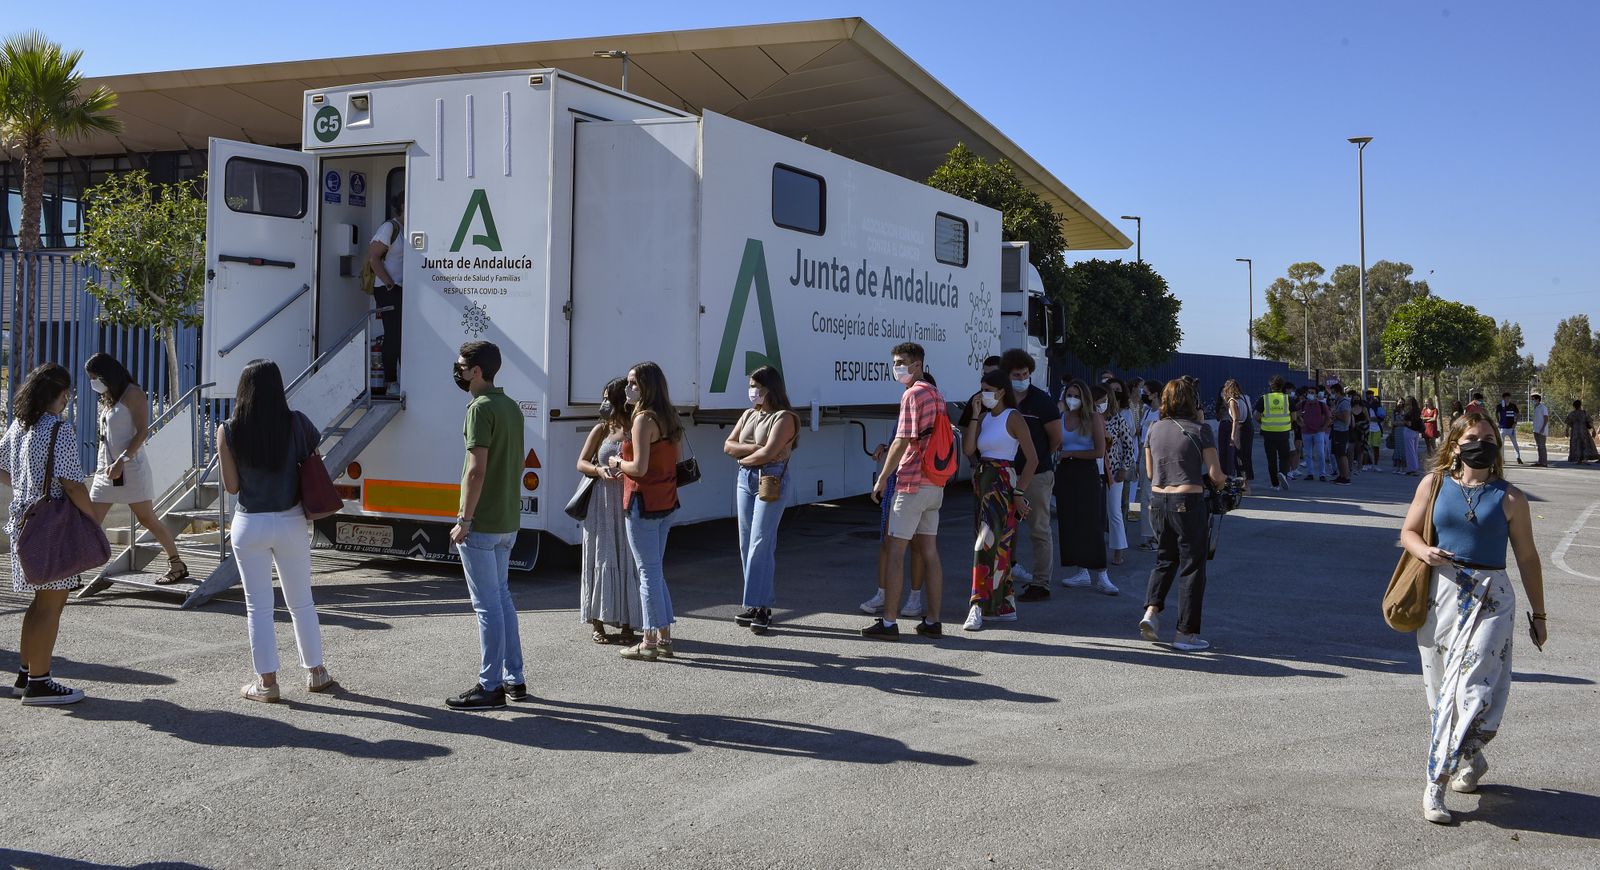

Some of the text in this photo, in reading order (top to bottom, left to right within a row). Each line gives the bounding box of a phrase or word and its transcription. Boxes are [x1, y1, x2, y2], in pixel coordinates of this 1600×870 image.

[316, 115, 339, 134] C5
[421, 254, 532, 269] Junta de Andalucía
[431, 273, 521, 284] Consejería de Salud y Familias
[789, 248, 959, 309] Junta de Andalucía
[443, 287, 508, 295] RESPUESTA COVID-19
[811, 310, 947, 343] Consejería de Salud y Familias
[834, 360, 891, 382] RESPUESTA
